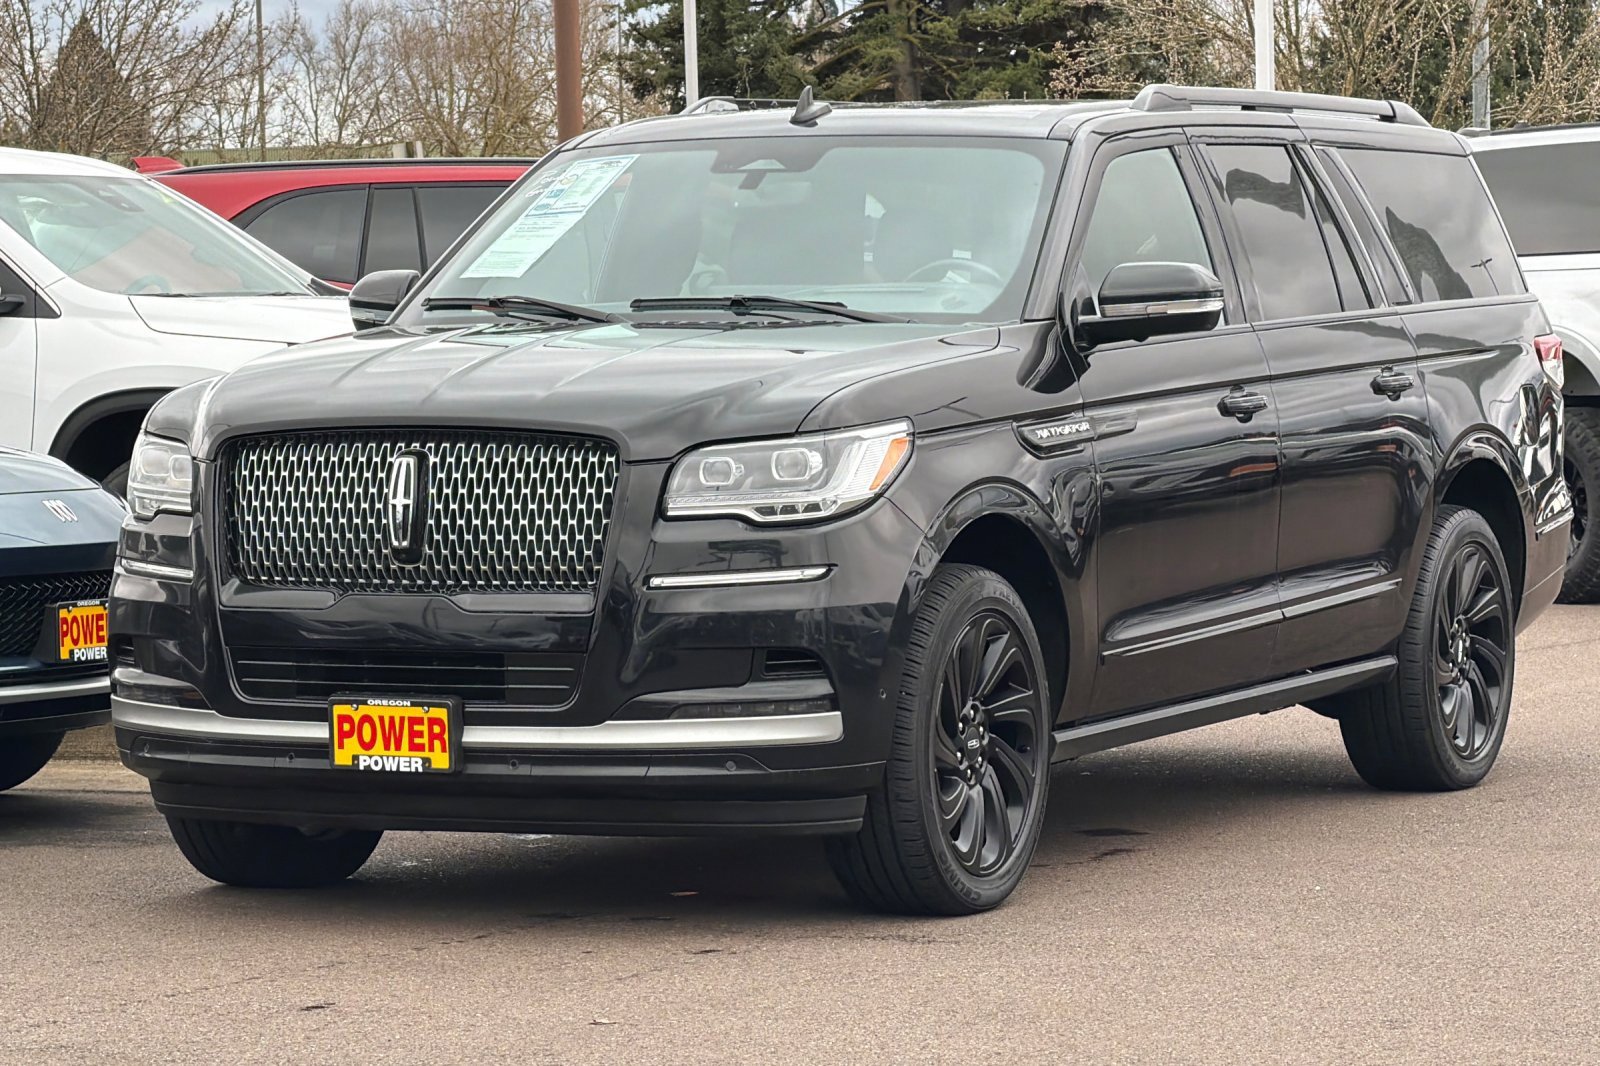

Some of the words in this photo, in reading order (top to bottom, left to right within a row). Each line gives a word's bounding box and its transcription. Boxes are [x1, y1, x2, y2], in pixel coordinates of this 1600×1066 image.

[60, 613, 108, 647] POWE
[74, 647, 107, 661] POWER
[337, 714, 448, 753] POWER
[358, 755, 423, 772] POWER
